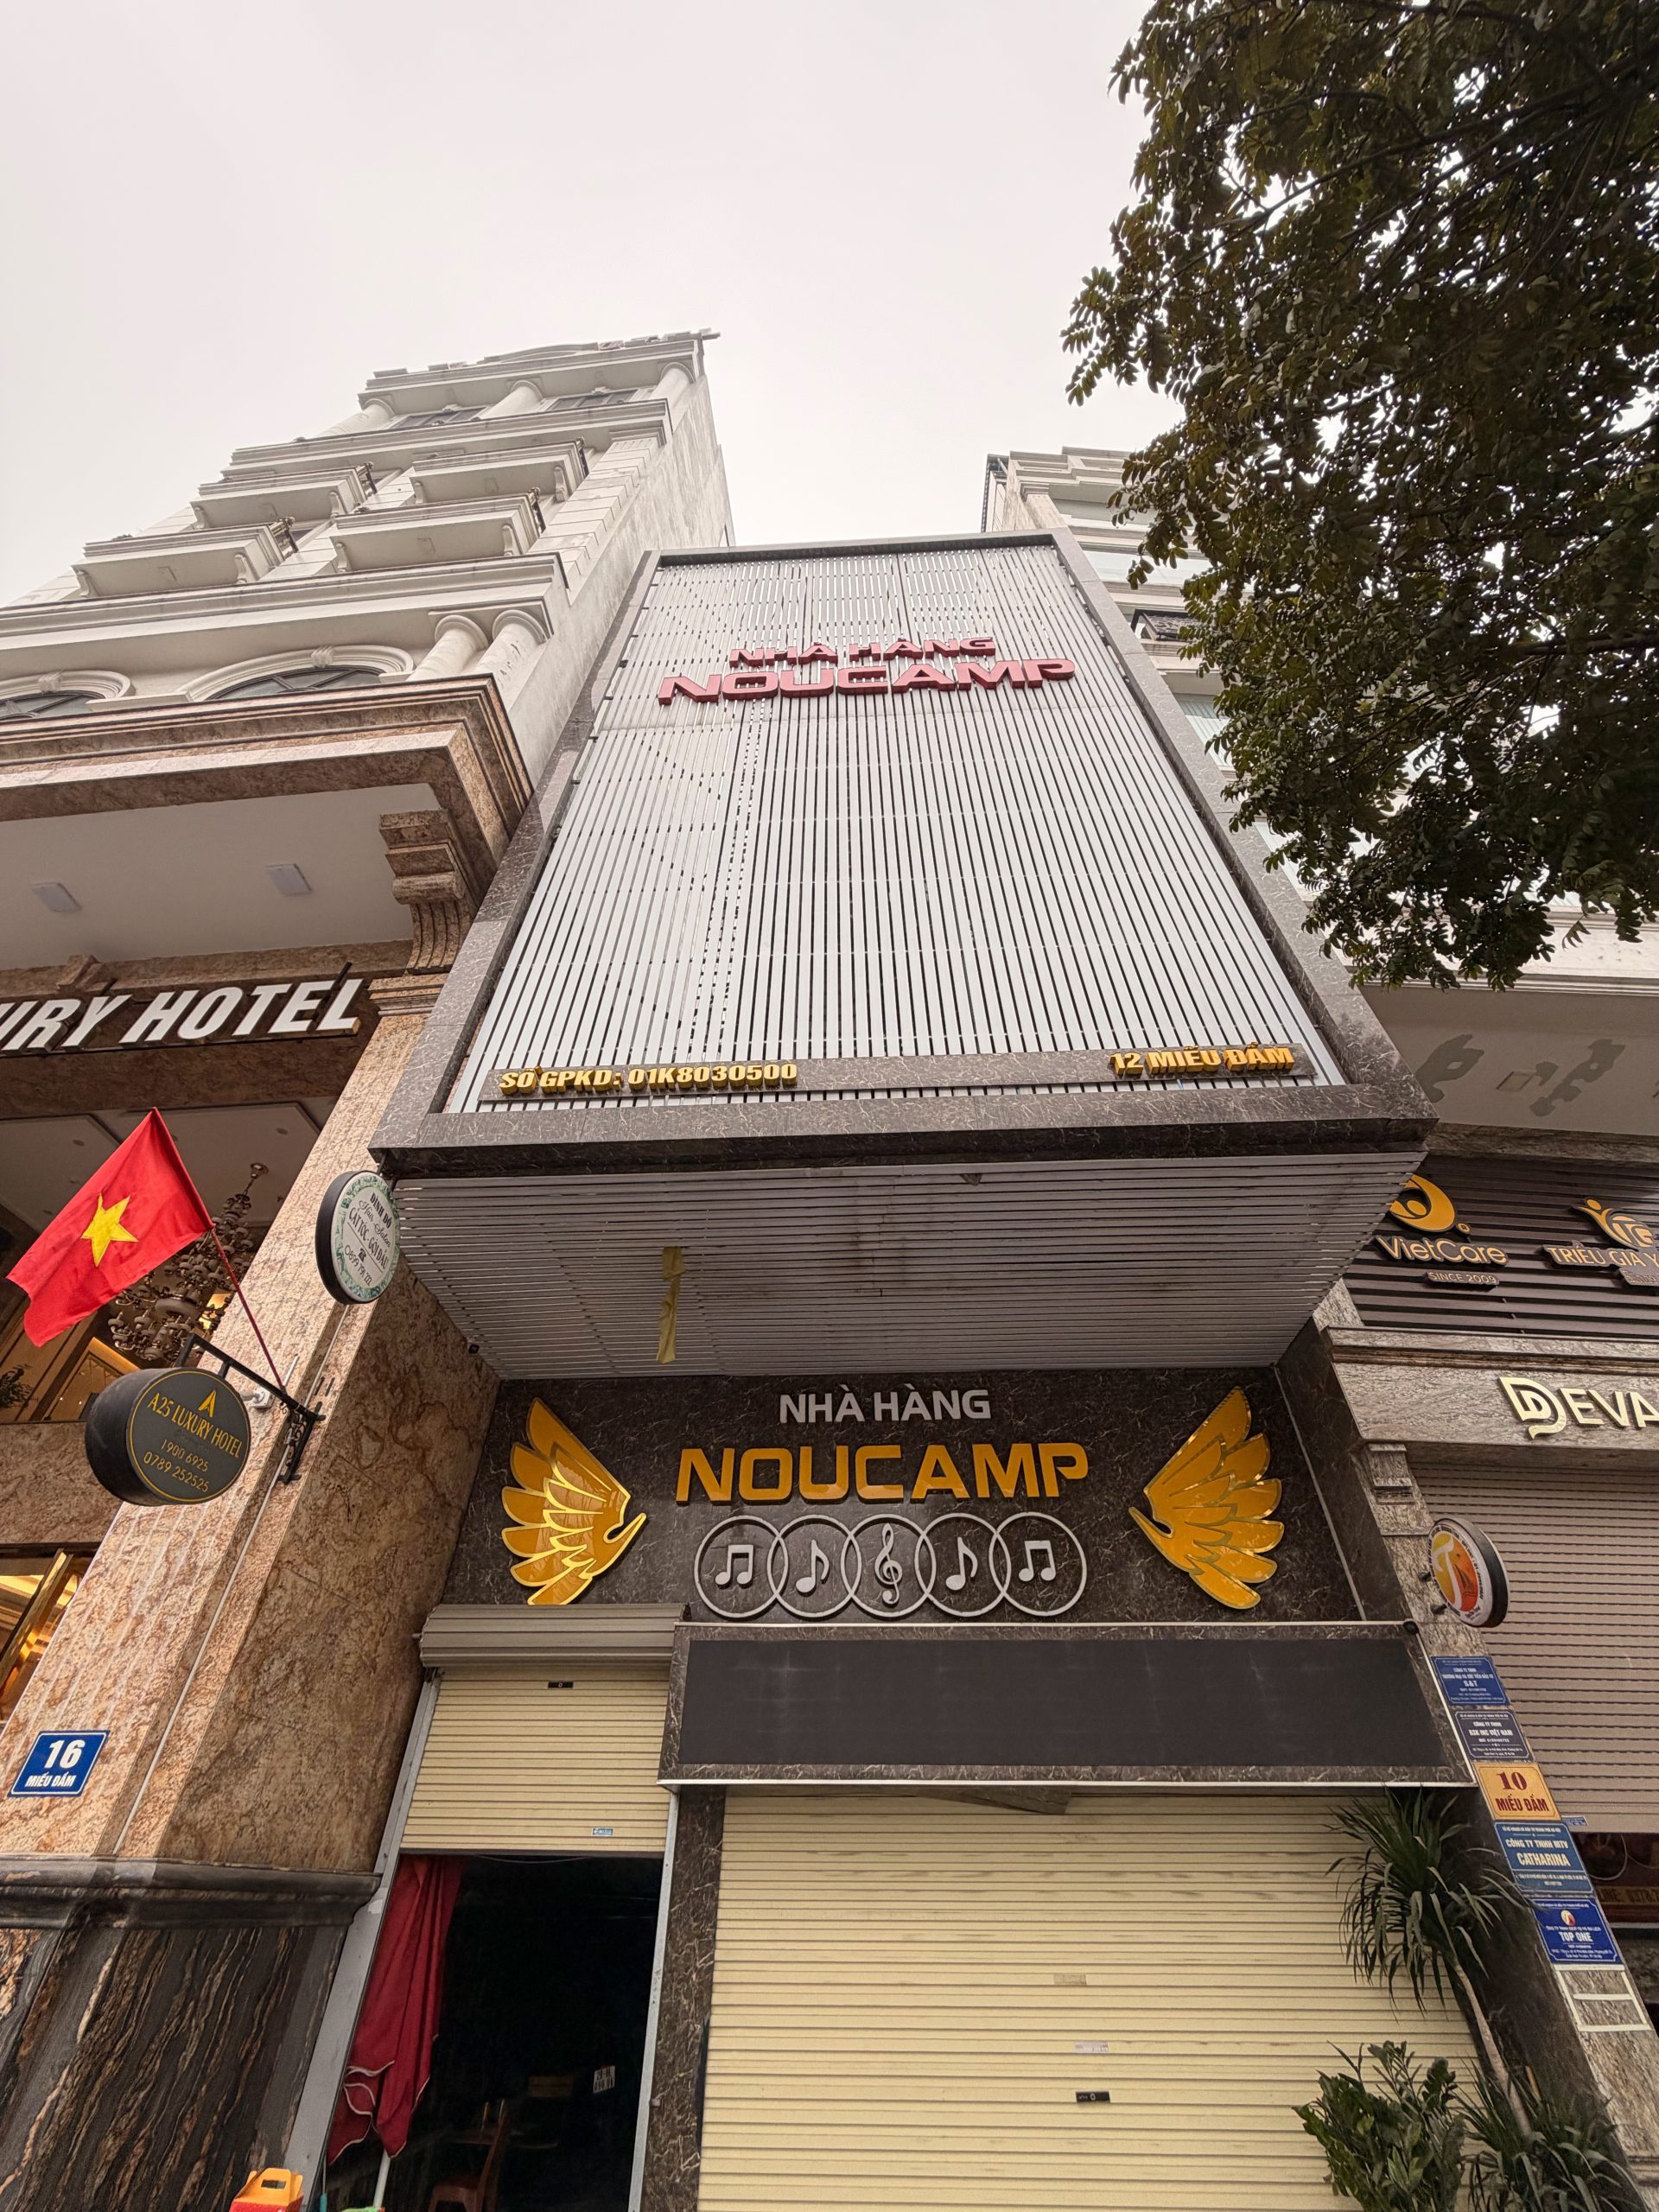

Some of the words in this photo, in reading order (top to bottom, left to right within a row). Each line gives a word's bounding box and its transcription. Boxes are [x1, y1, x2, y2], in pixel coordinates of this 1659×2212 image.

[729, 641, 838, 668] NHÀ
[849, 636, 996, 662] HÀNG
[658, 658, 1076, 706] NOUCAMP
[118, 978, 365, 1046] HOTEL
[627, 1063, 798, 1091] 01K8030500
[1109, 1052, 1144, 1076] 12
[359, 1199, 374, 1222] Hair
[373, 1223, 391, 1248] Salon
[1376, 1236, 1509, 1265] VietCare
[1608, 1250, 1647, 1268] GIA
[1428, 1271, 1464, 1282] SINCE
[1465, 1273, 1497, 1284] 2009
[779, 1383, 865, 1424] NHÀ
[873, 1382, 992, 1423] HÀNG
[147, 1392, 175, 1418] A25
[171, 1404, 214, 1440] LUXURY
[210, 1427, 243, 1459] HOTEL
[161, 1439, 186, 1459] 1900
[185, 1452, 209, 1472] 6925
[143, 1451, 172, 1473] 0789
[172, 1467, 210, 1493] 252525
[676, 1442, 1089, 1505] NOUCAMP
[44, 1739, 86, 1770] 16
[1497, 1771, 1528, 1791] 10
[1505, 1838, 1525, 1848] CÔNG
[1525, 1839, 1534, 1848] TY
[1516, 1852, 1572, 1867] CATHARINA
[1558, 1931, 1574, 1942] TOP
[1575, 1931, 1594, 1942] ONE
